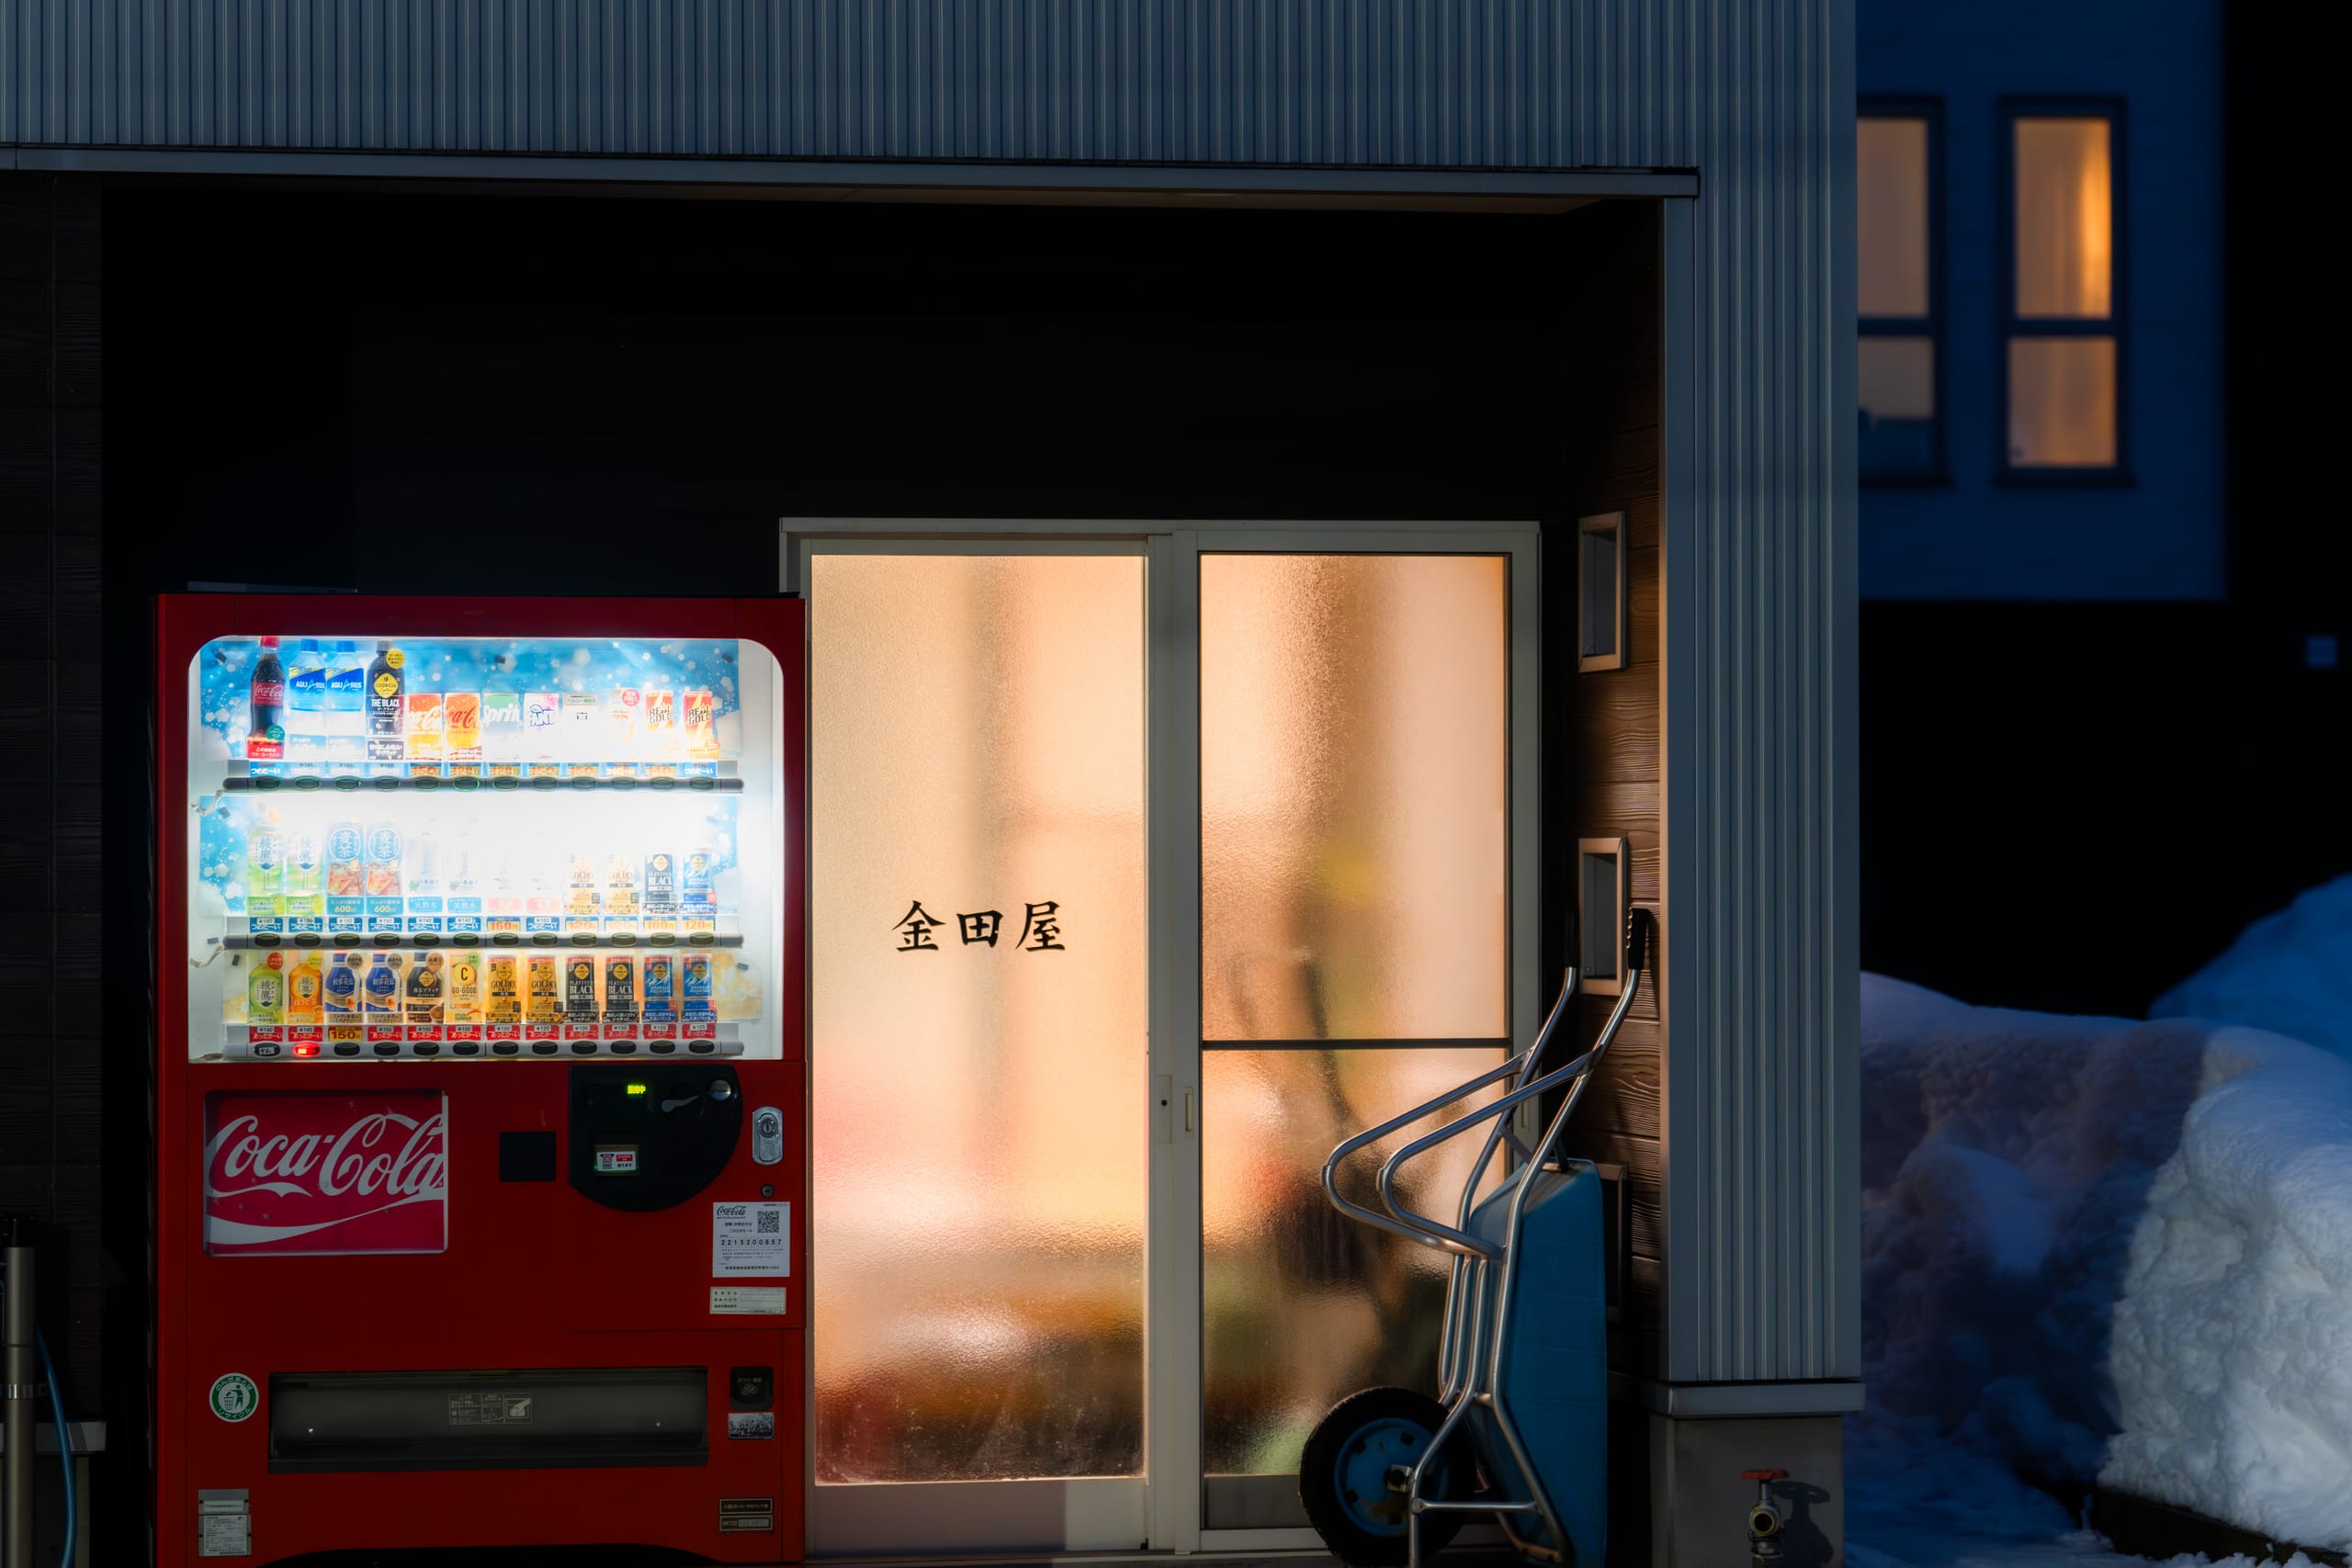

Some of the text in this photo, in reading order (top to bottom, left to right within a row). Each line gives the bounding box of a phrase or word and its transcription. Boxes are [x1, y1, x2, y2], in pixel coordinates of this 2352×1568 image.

[892, 899, 1065, 952] 金田屋
[461, 967, 468, 981] C
[570, 985, 594, 994] BLACK
[608, 985, 632, 994] BLACK
[206, 1113, 444, 1198] Coca-Cola
[717, 1205, 747, 1216] Coca-Cola
